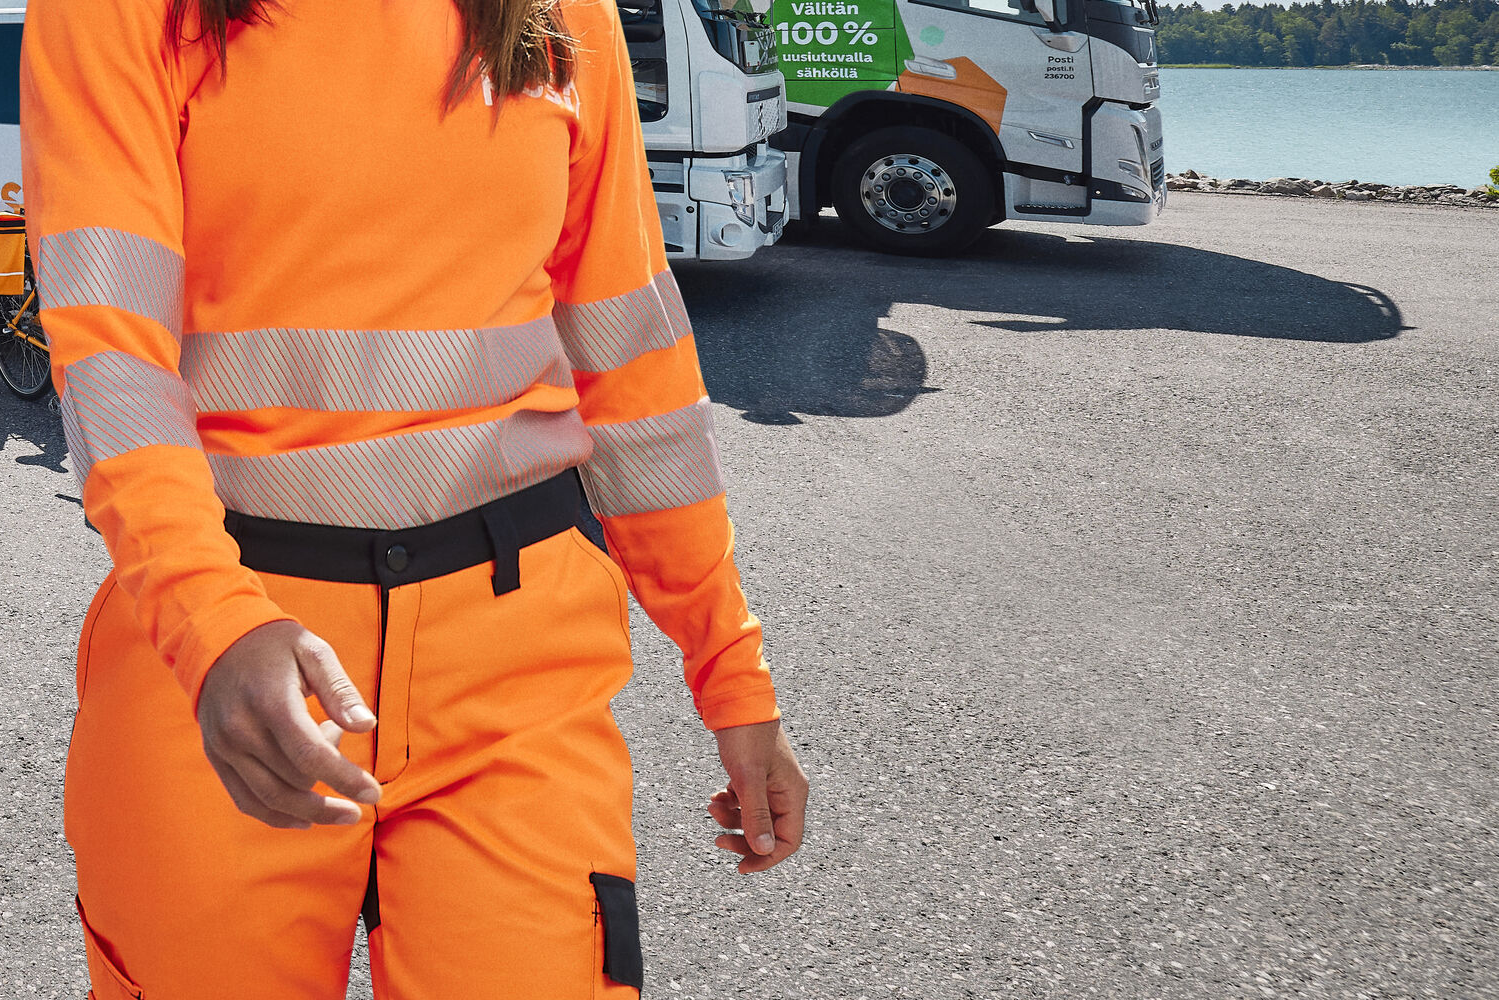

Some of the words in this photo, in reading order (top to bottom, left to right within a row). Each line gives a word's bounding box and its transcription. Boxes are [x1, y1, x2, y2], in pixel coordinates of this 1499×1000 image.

[791, 1, 859, 16] Välitän
[782, 51, 873, 63] uusiutuvalla
[1047, 55, 1074, 64] Posti
[796, 67, 858, 79] sähköllä
